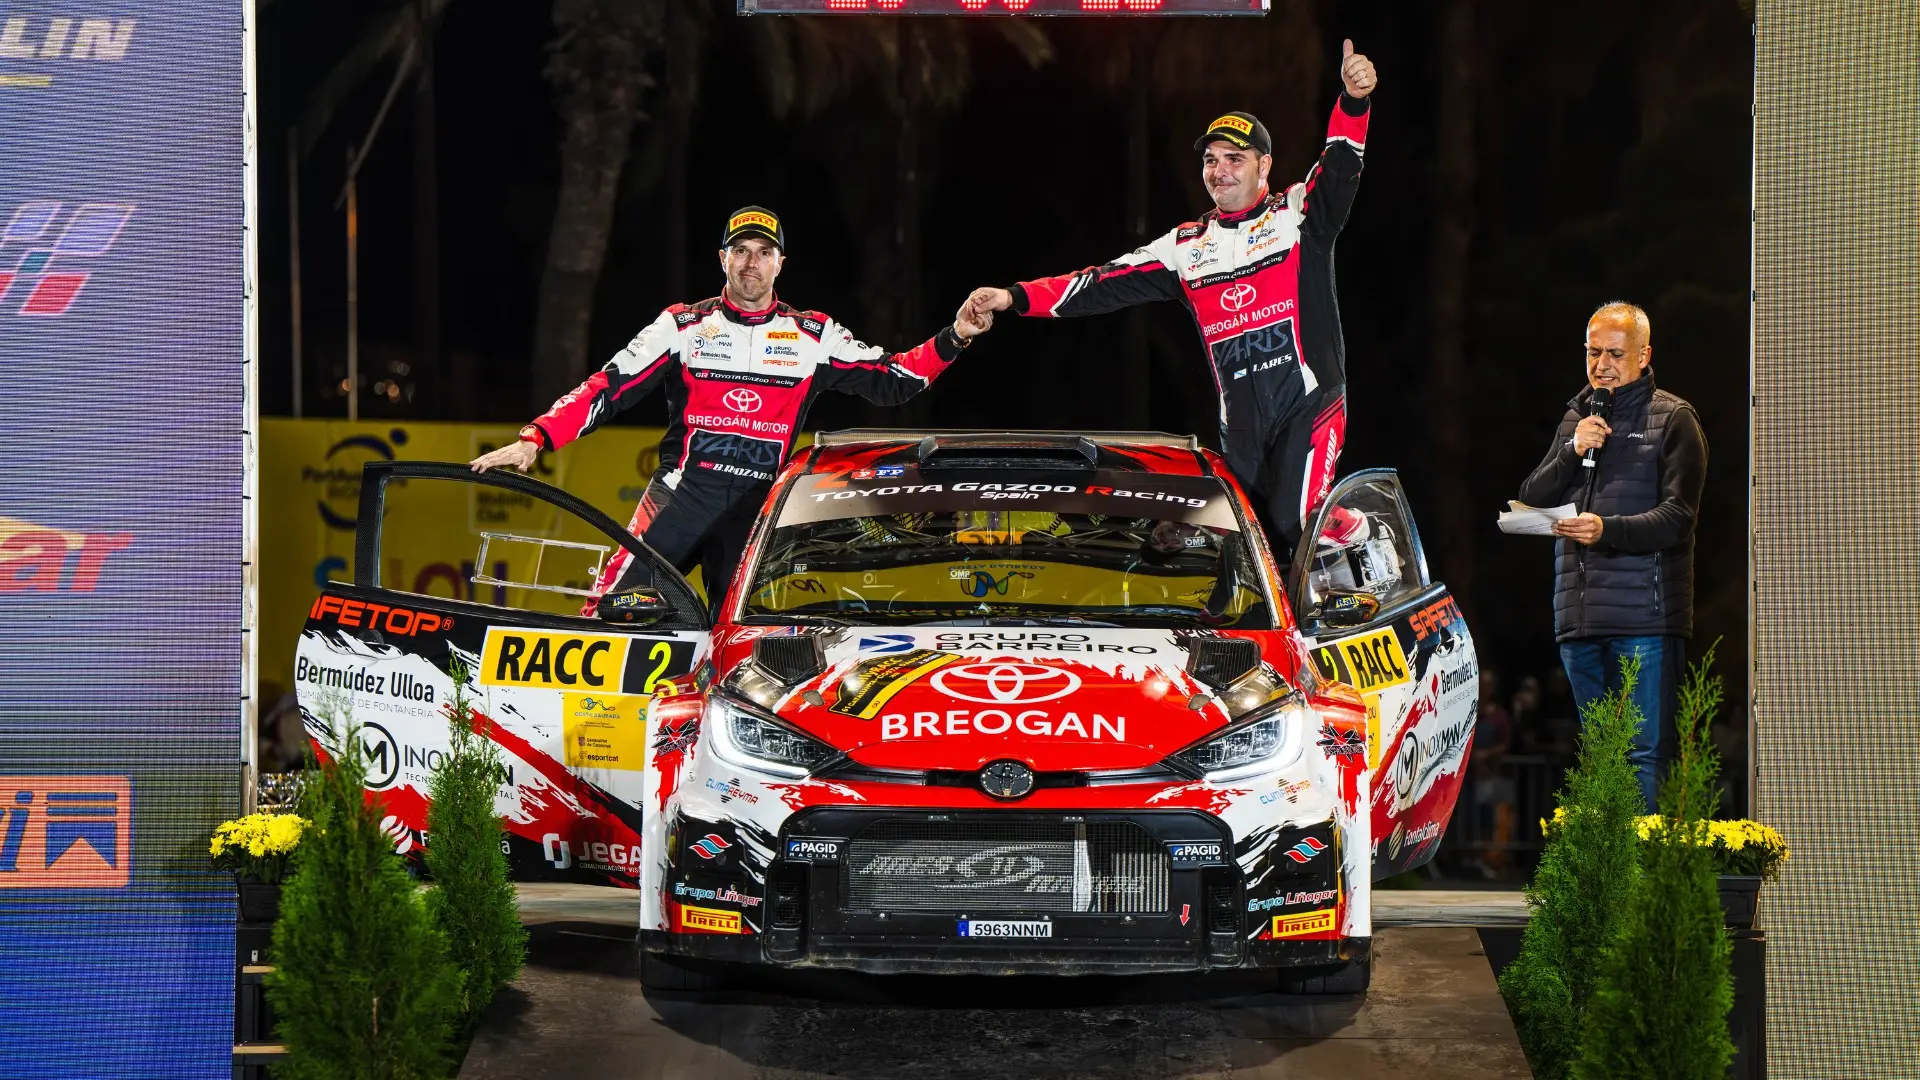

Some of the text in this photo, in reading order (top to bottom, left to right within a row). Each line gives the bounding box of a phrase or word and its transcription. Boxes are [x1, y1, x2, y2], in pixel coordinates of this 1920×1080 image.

[1202, 274, 1230, 285] TOYOTA
[1251, 299, 1294, 322] MOTOR
[710, 372, 741, 380] TOYOTA
[769, 377, 795, 387] Racing
[688, 414, 789, 435] BREOGÁN MOTOR
[811, 482, 1208, 508] TOYOTA GAZOO Racing
[979, 491, 1040, 501] Spain
[1184, 537, 1206, 547] OMP
[949, 569, 971, 579] OMP
[934, 633, 1090, 642] GRUPO
[935, 641, 1158, 655] BARREIRO
[496, 635, 611, 687] RACC
[643, 641, 672, 694] 2
[1345, 635, 1404, 689] RACC
[297, 655, 435, 703] Bermúdez Ulloa
[357, 698, 372, 710] DE
[881, 709, 1126, 742] BREOGAN
[705, 778, 759, 805] CLIMAREYMA
[1259, 779, 1312, 805] CLIMAREYMA
[801, 842, 837, 853] PAGID
[1184, 845, 1221, 856] PAGID
[675, 883, 715, 900] Grupo
[1248, 895, 1284, 911] Grupo
[686, 909, 739, 930] PIRELLI
[1277, 913, 1331, 934] PIRELLI
[974, 923, 1048, 936] 5963NNM
